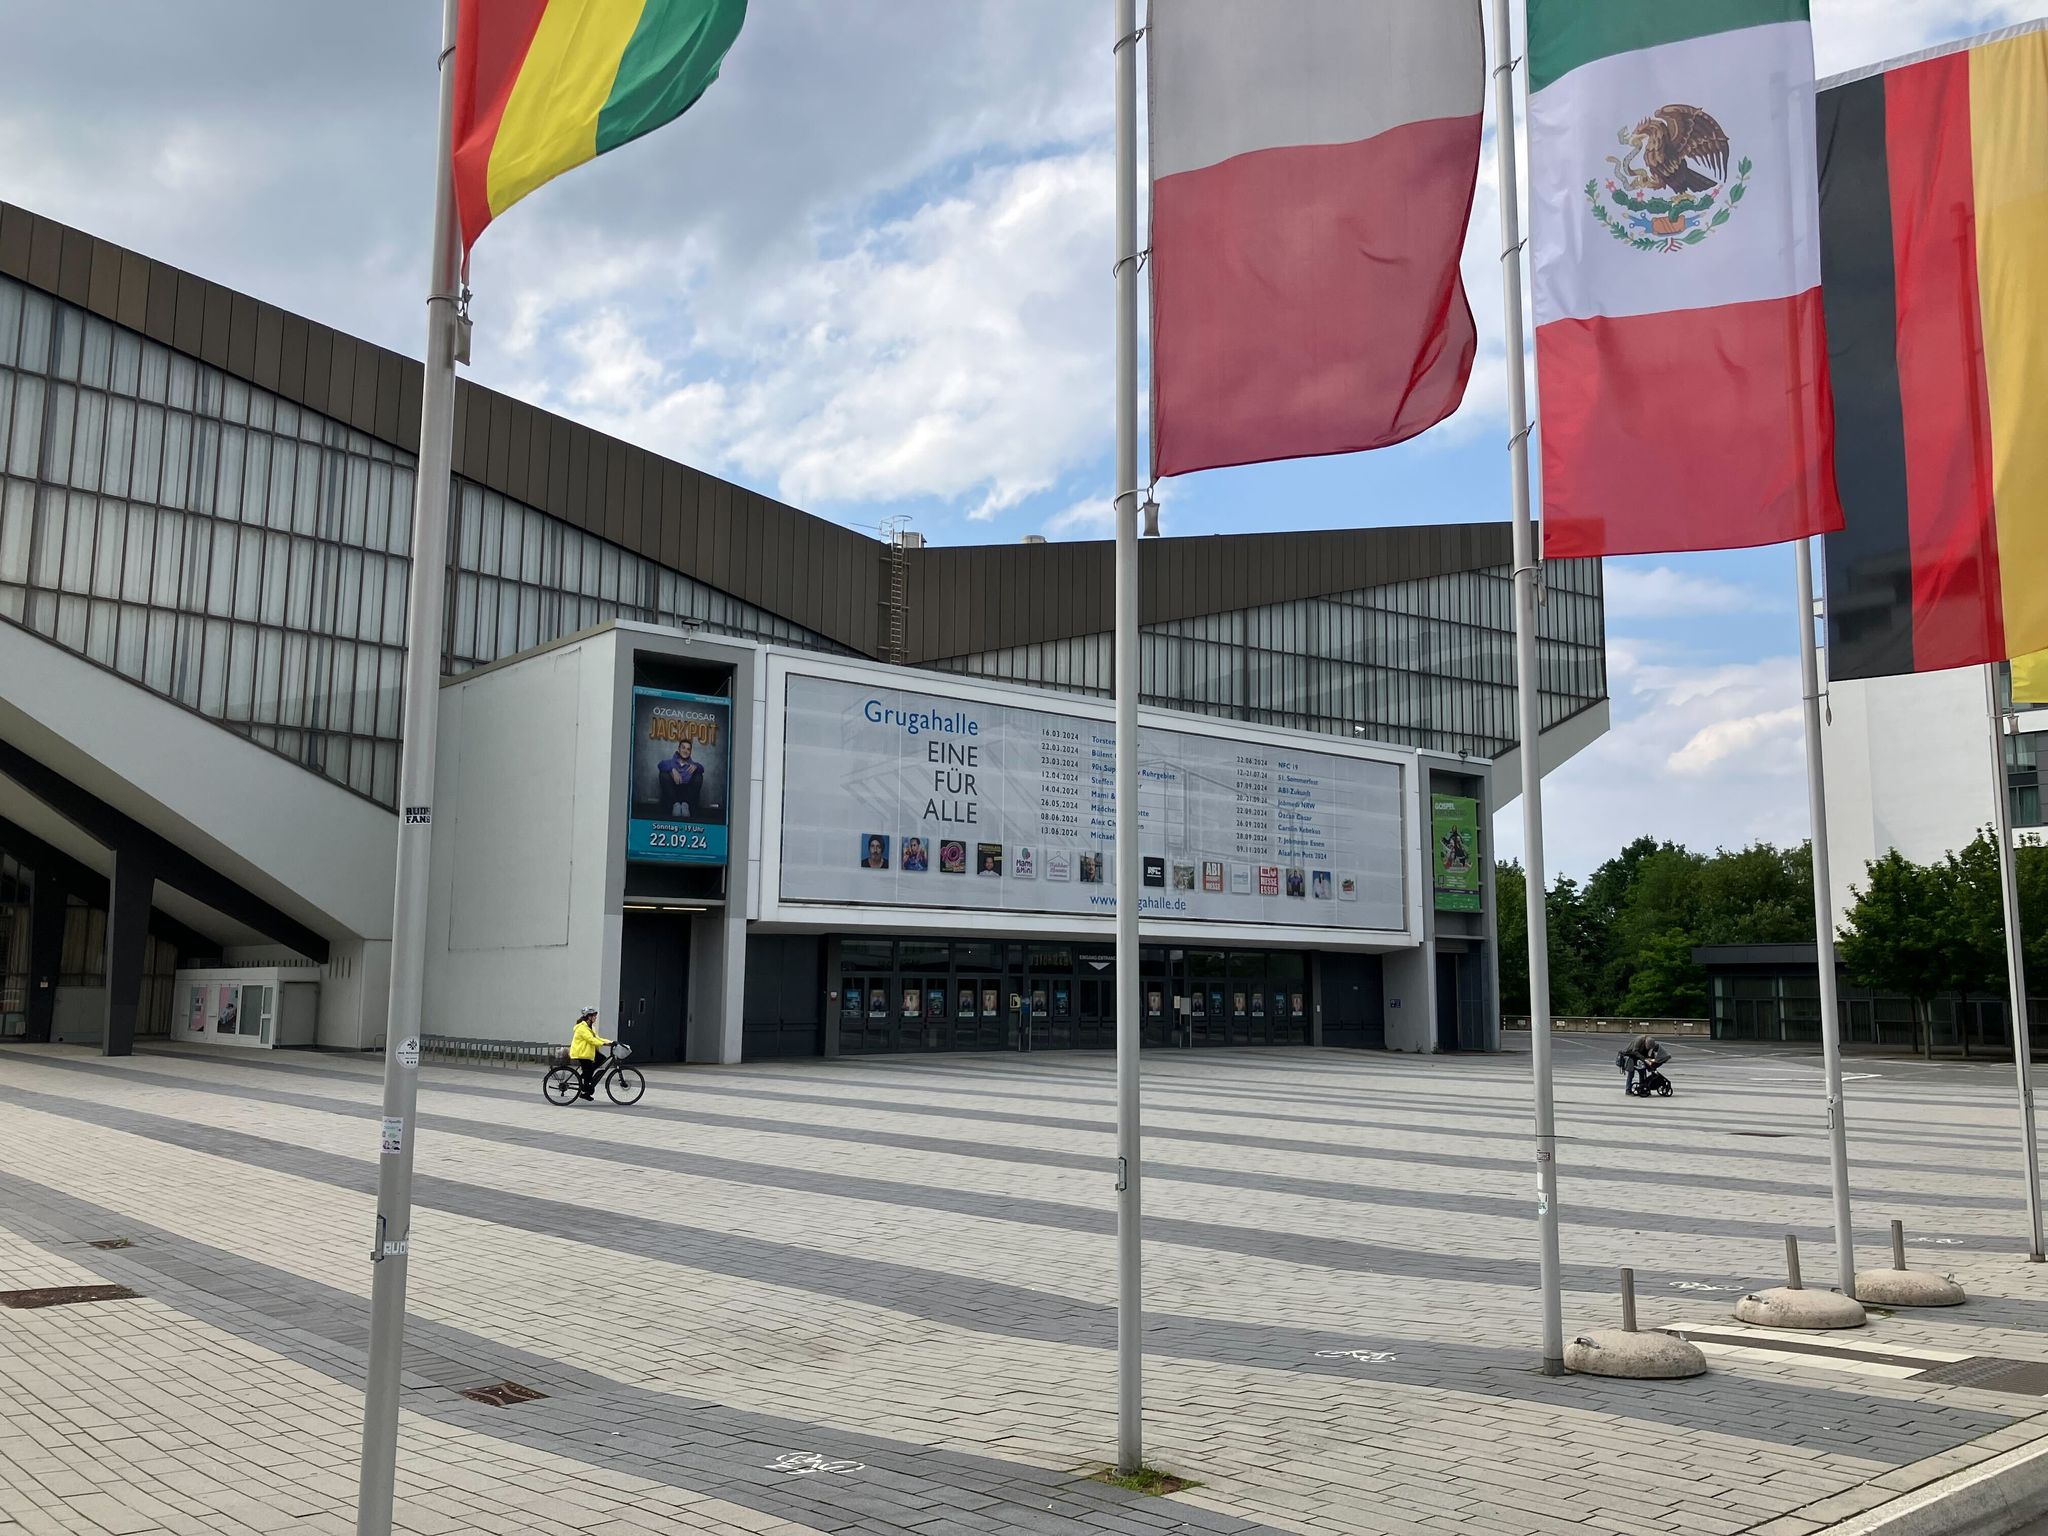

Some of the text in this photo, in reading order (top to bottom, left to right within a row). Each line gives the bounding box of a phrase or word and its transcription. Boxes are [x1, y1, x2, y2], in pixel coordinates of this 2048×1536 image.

[864, 700, 978, 735] Grugahalle
[649, 716, 719, 746] JACKPOT
[1042, 728, 1116, 745] 16.03.2024 Torsten
[928, 741, 978, 767] EINE
[1042, 742, 1078, 754] 22.03.2024
[1042, 756, 1078, 768] 23.03.2024
[1103, 765, 1116, 774] Sup
[1236, 756, 1268, 766] 22.06.2024
[935, 767, 978, 796] FÜR
[1042, 771, 1114, 786] 12.04.2024 Steffen
[1042, 784, 1078, 796] 14.04.2024
[923, 798, 978, 824] ALLE
[1042, 798, 1078, 810] 26.05.2024
[1040, 812, 1078, 824] 08.06.2024
[1091, 818, 1106, 826] Alex
[652, 822, 679, 832] Sonntag
[692, 825, 705, 833] Uhr
[1040, 826, 1116, 841] 13.06.2024 Michael
[649, 832, 707, 849] 22.09.24
[1205, 862, 1221, 876] ABI
[1090, 896, 1186, 910] wwwgahalle.de
